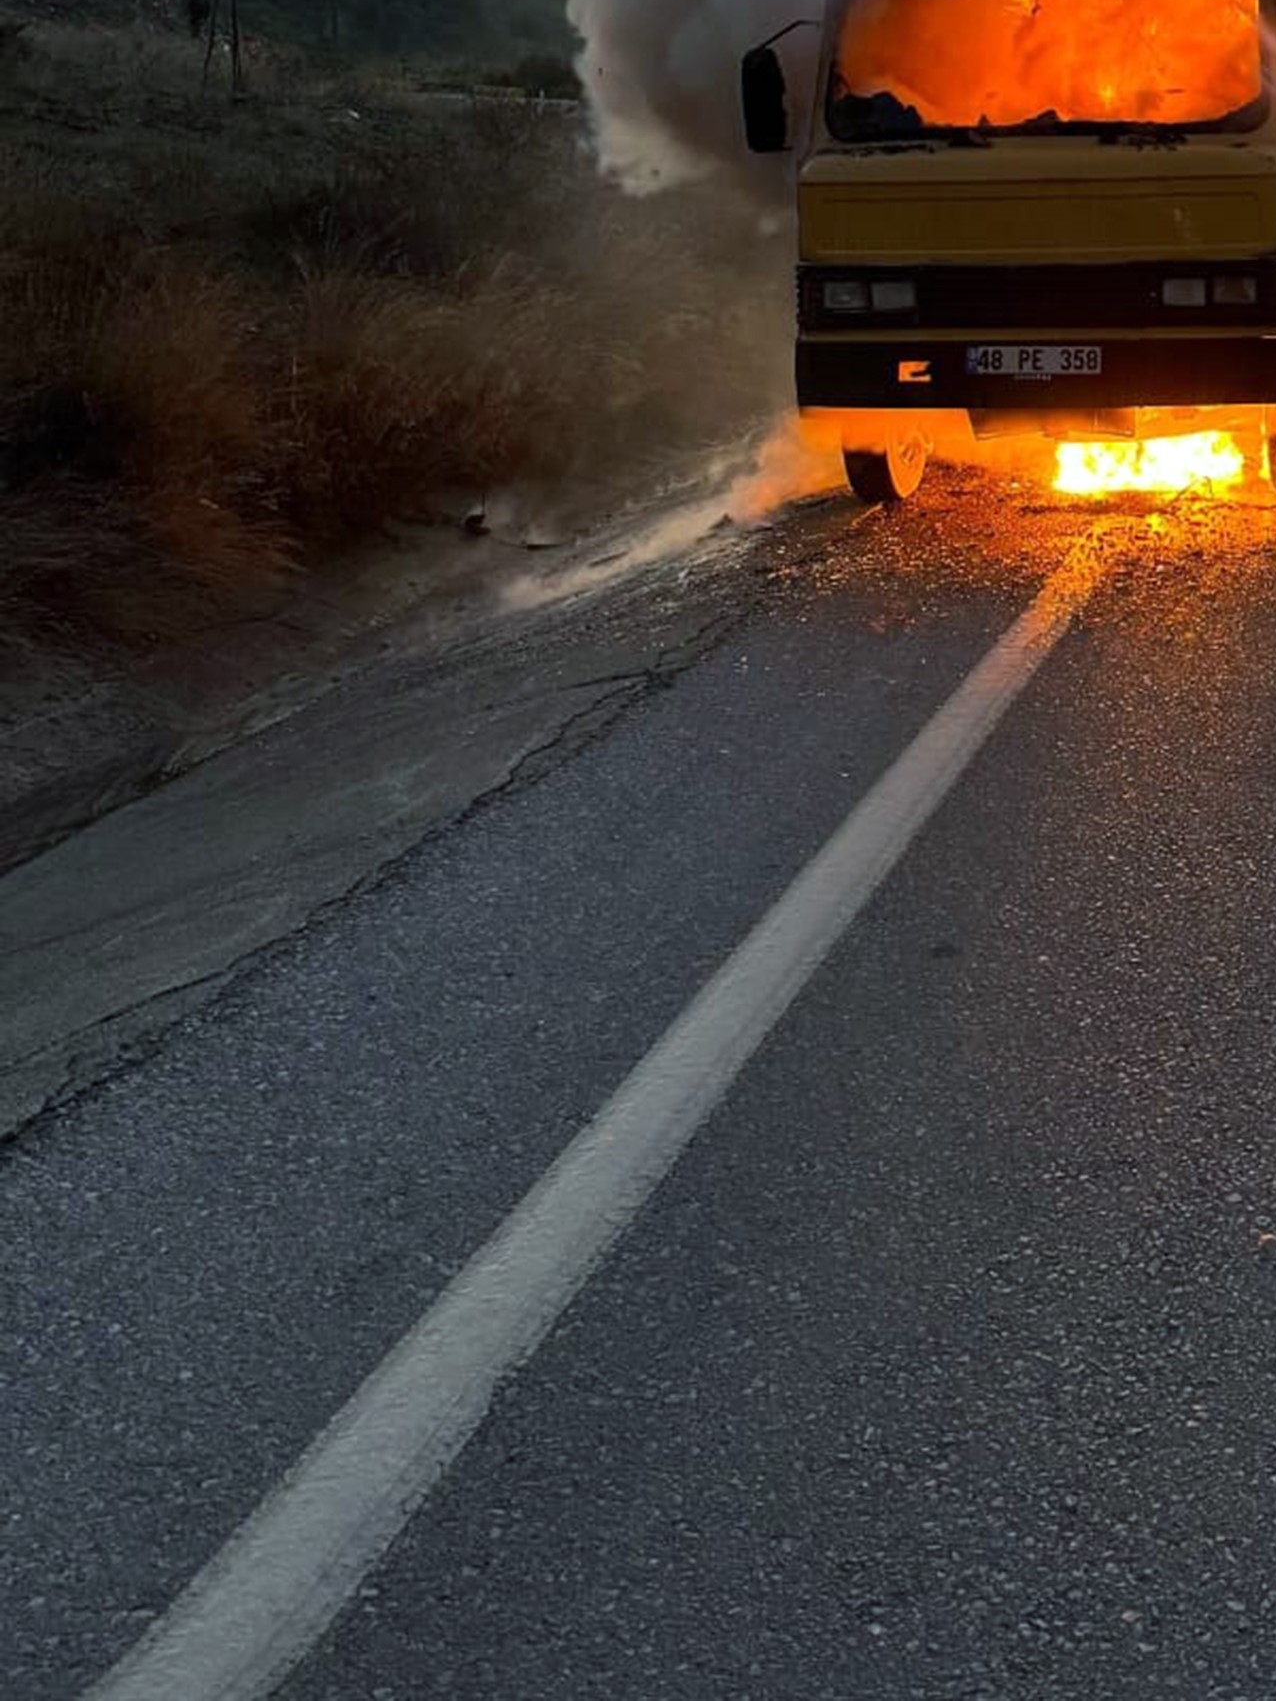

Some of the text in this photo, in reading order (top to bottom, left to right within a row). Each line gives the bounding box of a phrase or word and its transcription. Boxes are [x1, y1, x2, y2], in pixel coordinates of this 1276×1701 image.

[978, 349, 1003, 370] 48
[1018, 349, 1044, 370] PE
[1060, 349, 1098, 370] 358
